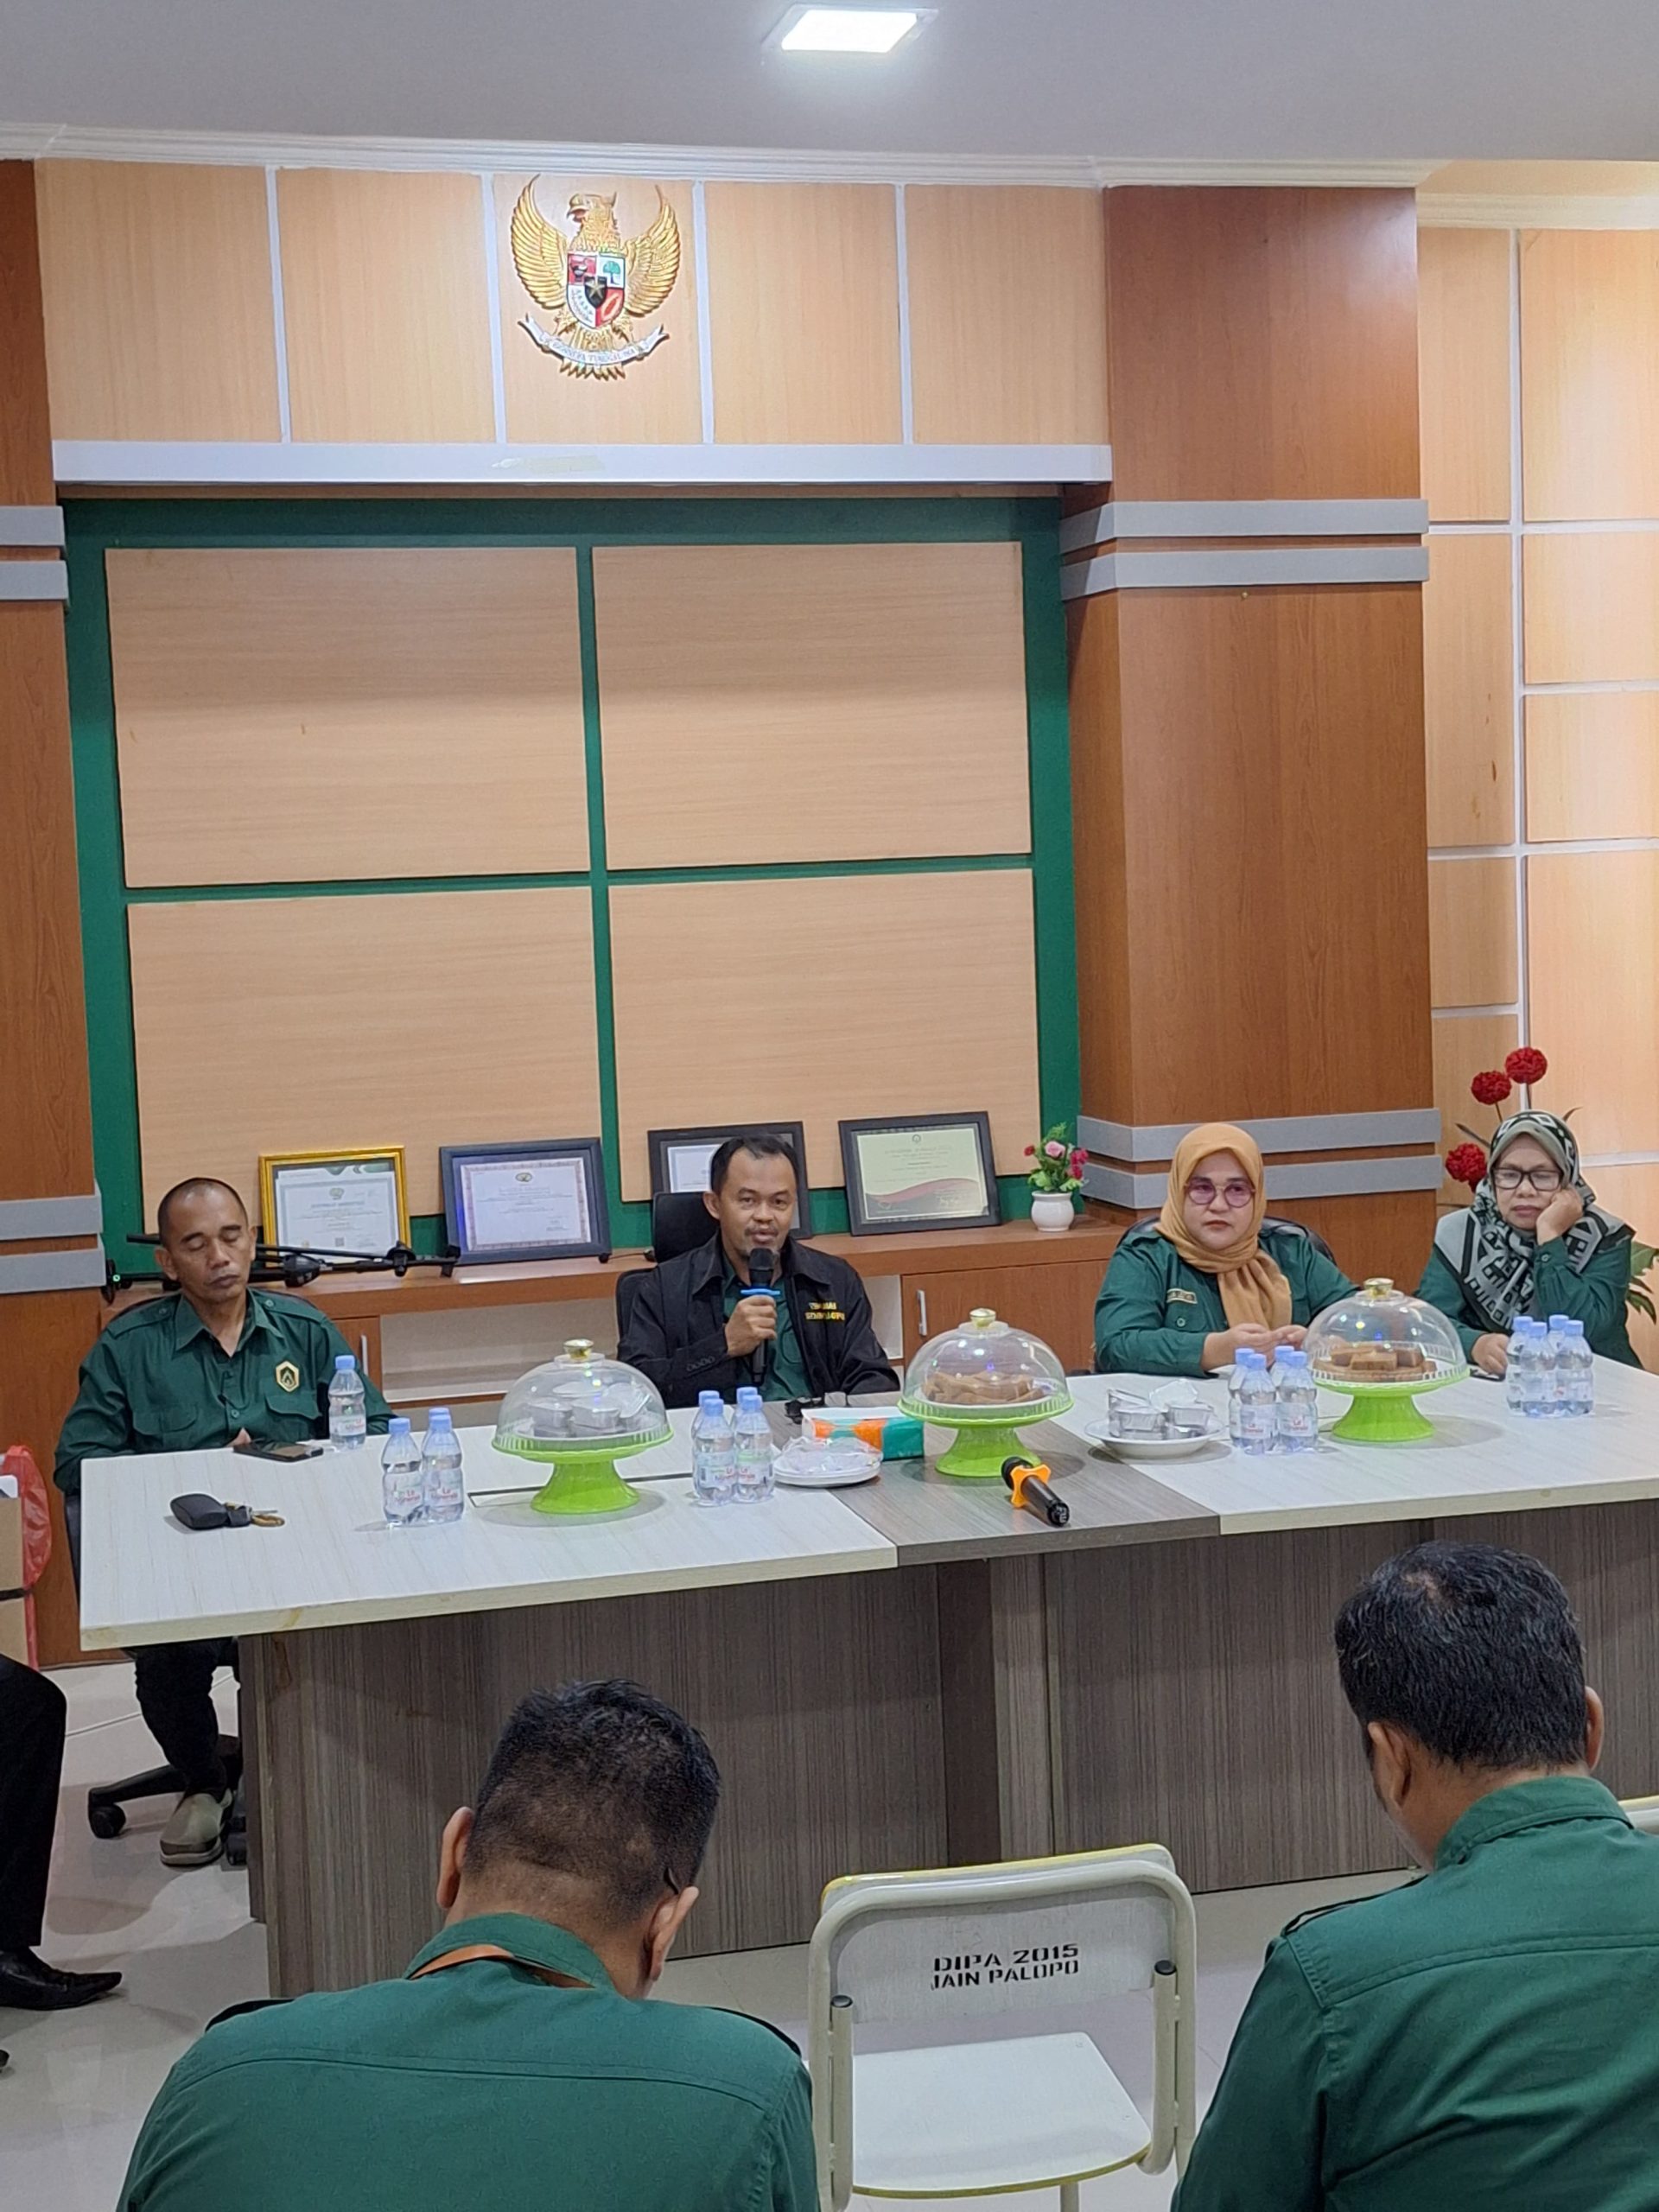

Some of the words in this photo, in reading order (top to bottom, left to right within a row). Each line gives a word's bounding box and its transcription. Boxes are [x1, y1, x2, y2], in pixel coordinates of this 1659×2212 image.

[934, 1953, 1001, 1972] DIPA
[1013, 1943, 1078, 1964] 2015
[933, 1971, 980, 1989] IAIN
[988, 1960, 1078, 1984] PALOPO
